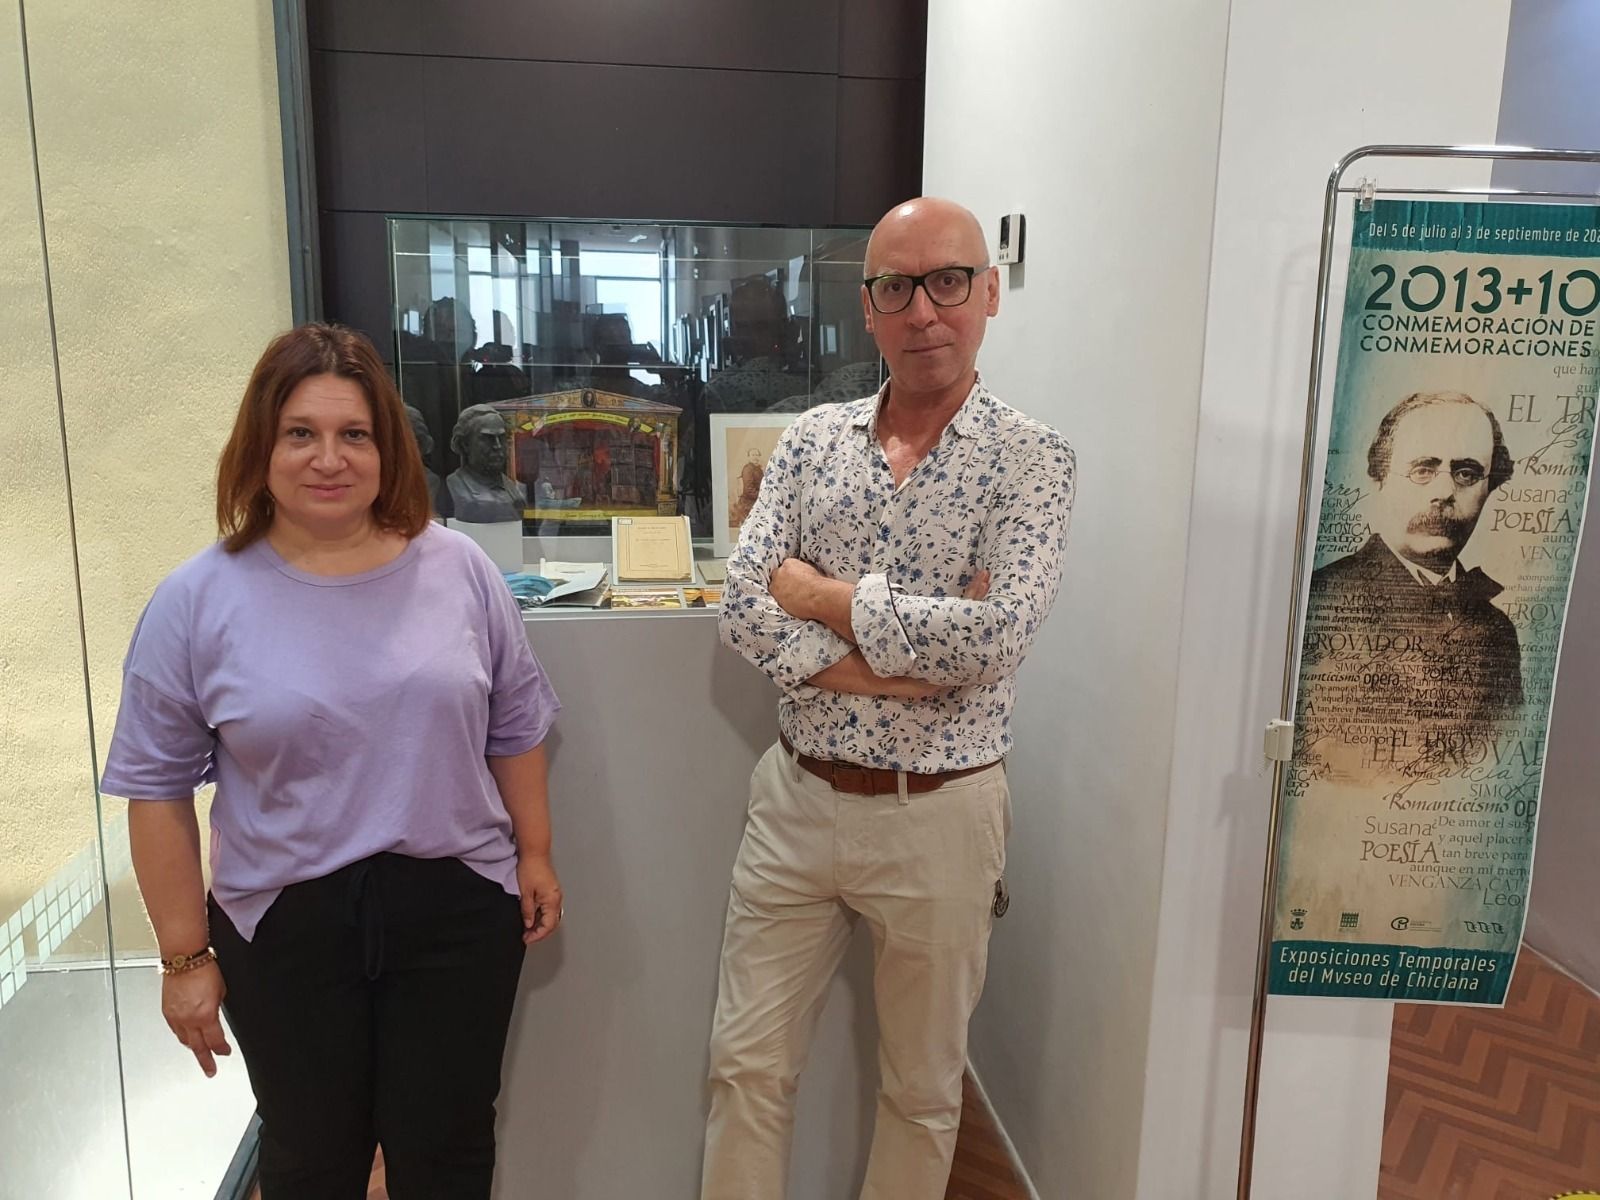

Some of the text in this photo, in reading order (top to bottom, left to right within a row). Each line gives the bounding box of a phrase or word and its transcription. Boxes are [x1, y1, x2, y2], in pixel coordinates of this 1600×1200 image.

[1369, 222, 1387, 237] Del
[1391, 223, 1398, 238] 5
[1402, 224, 1416, 238] de
[1419, 224, 1446, 241] julio
[1451, 225, 1462, 239] al
[1465, 225, 1472, 239] 3
[1476, 226, 1490, 240] de
[1495, 226, 1561, 244] septiembre
[1566, 228, 1580, 242] de
[1364, 263, 1600, 316] 2013+10
[1362, 314, 1596, 337] CONMEMORACIÓN DE
[1360, 335, 1593, 358] CONMEMORACIONES
[1553, 365, 1577, 378] que
[1507, 394, 1595, 423] EL TR
[1497, 480, 1567, 503] Susana
[1490, 507, 1575, 534] POESÍA
[1363, 673, 1400, 689] opera
[1383, 794, 1509, 814] Romanticismo
[1364, 816, 1433, 837] Susana
[1459, 820, 1492, 829] amor
[1494, 817, 1505, 829] el
[1438, 834, 1446, 846] y
[1449, 833, 1483, 847] aquel
[1360, 840, 1440, 864] POESÍA
[1442, 848, 1462, 859] tan
[1465, 848, 1499, 860] breve
[1409, 863, 1457, 877] aunque
[1459, 866, 1474, 875] en
[1478, 866, 1493, 875] mi
[1388, 873, 1482, 890] VENGANZA
[1280, 946, 1497, 974] Exposiciones Temporales
[1288, 967, 1479, 991] del Mvseo de Chiclana
